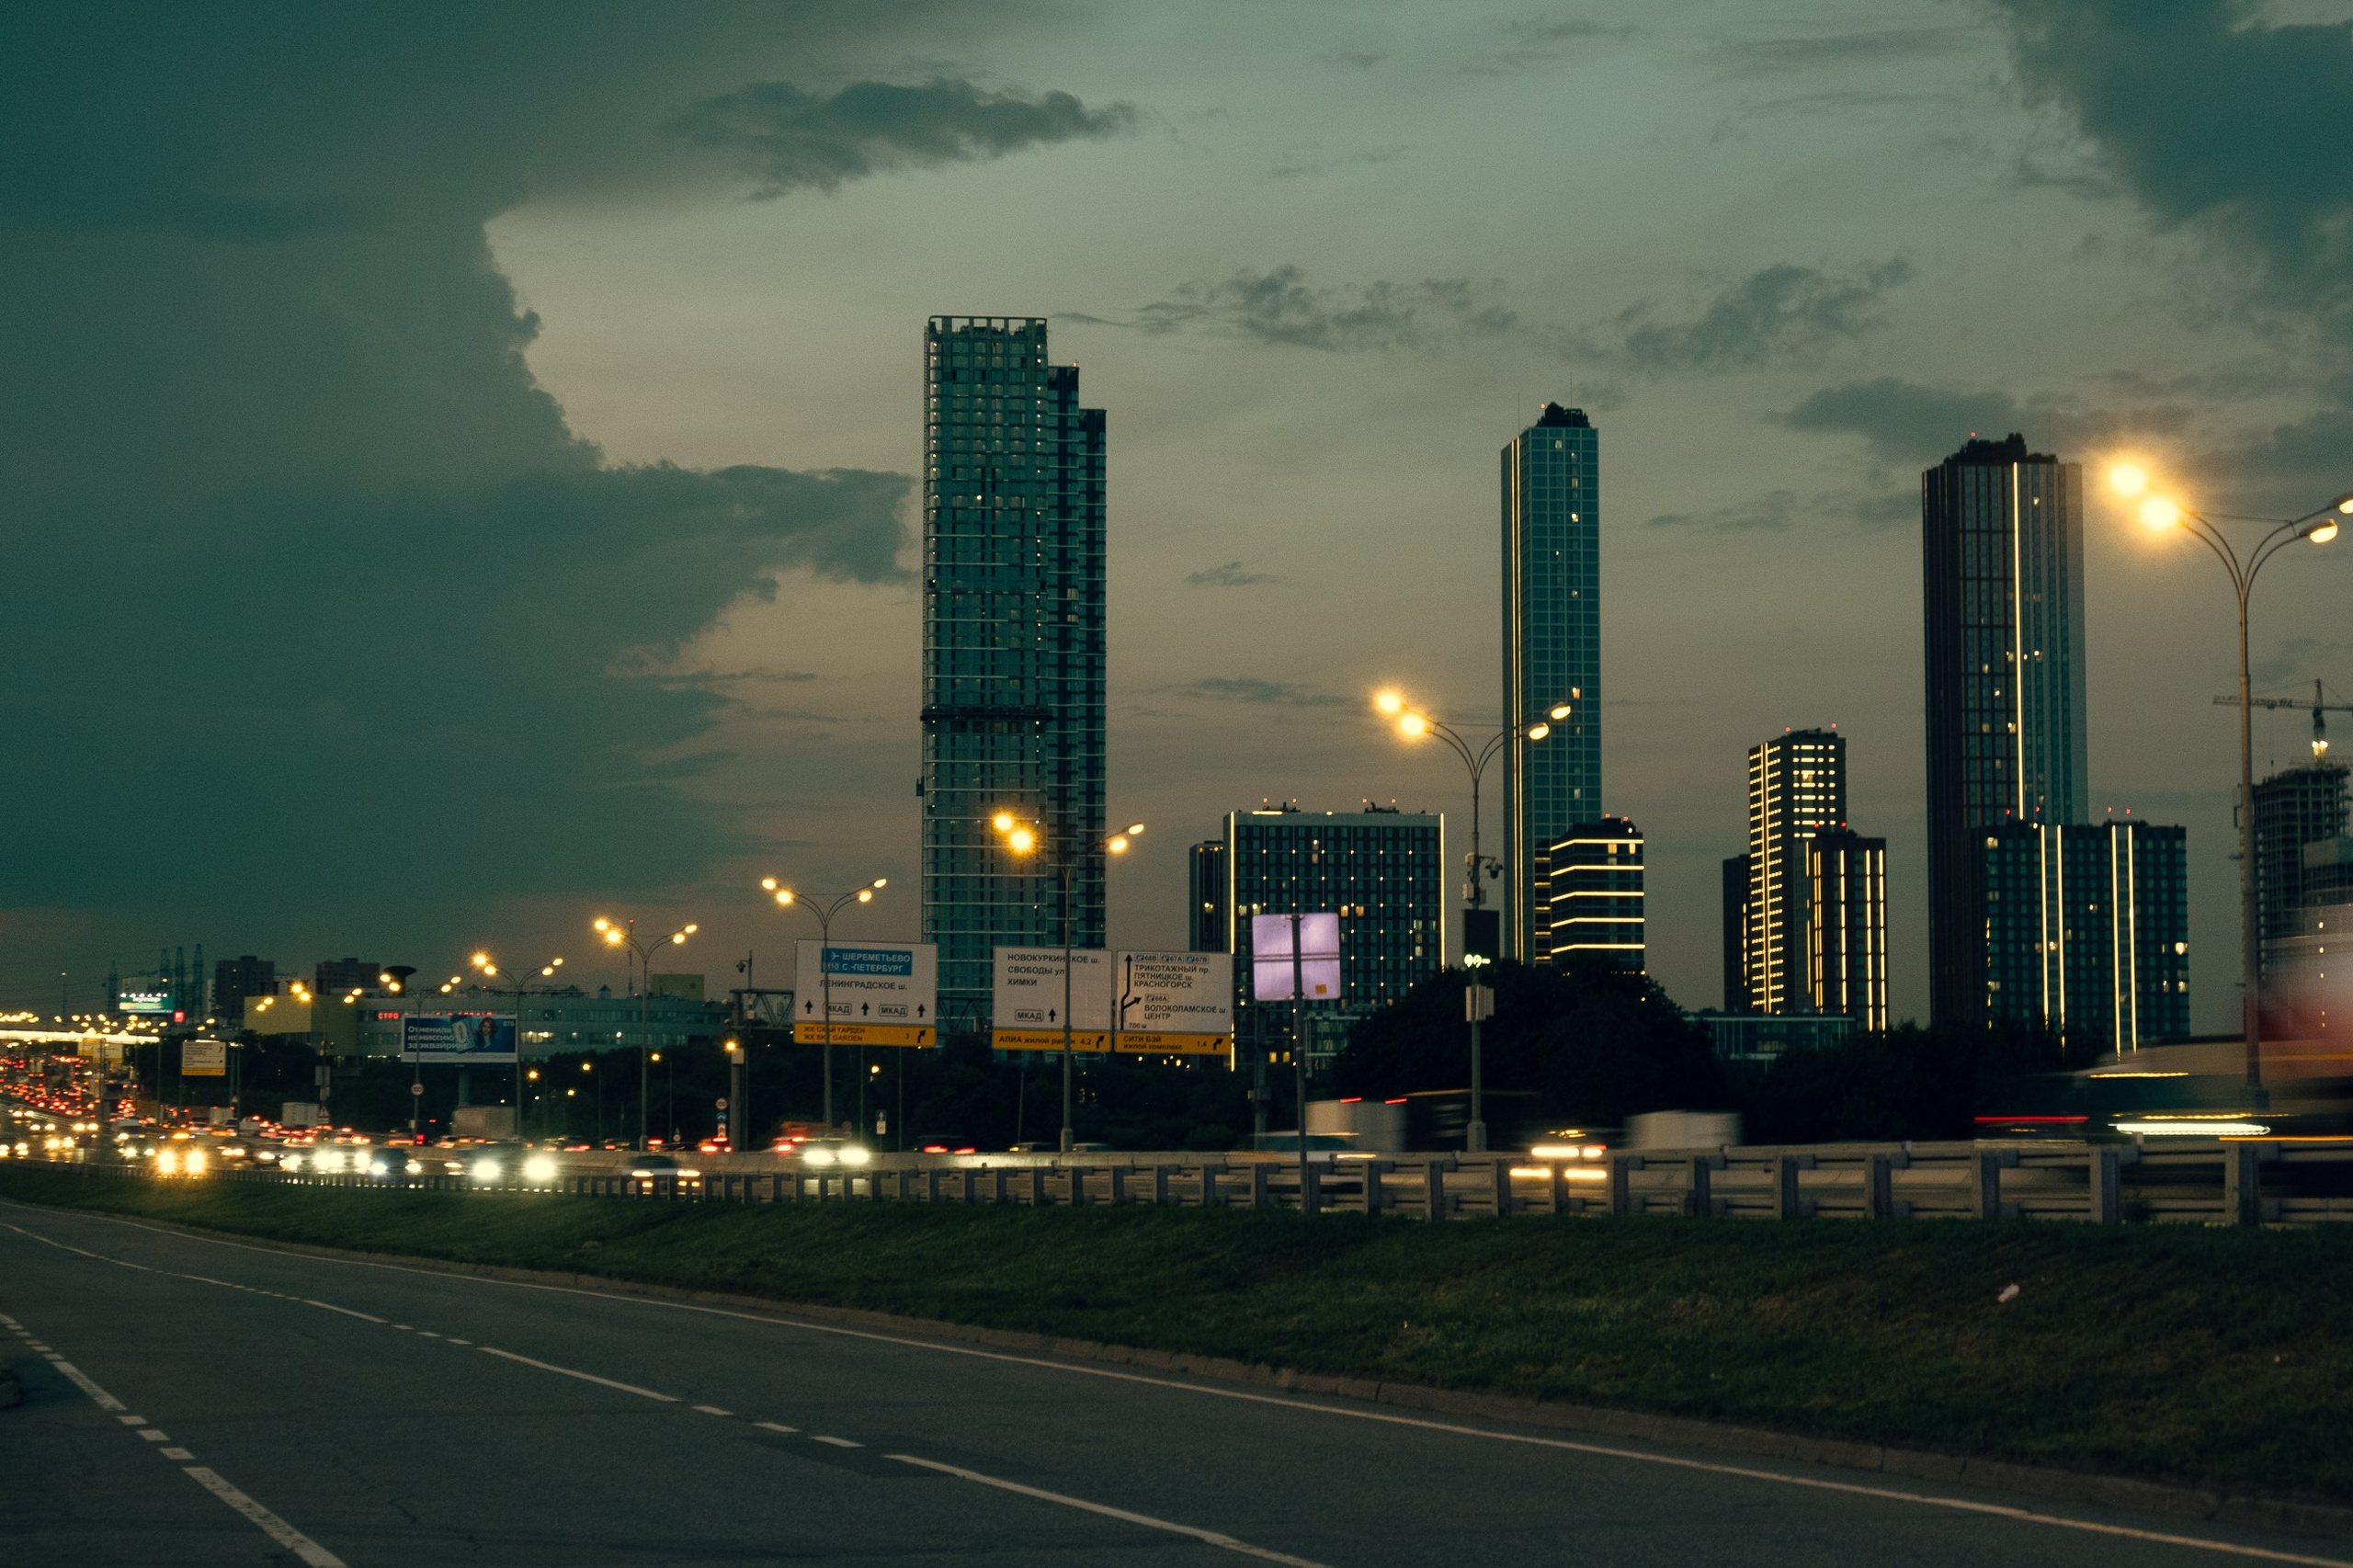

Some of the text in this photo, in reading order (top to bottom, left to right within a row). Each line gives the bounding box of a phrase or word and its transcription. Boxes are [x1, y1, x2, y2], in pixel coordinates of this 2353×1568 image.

[842, 953, 911, 962] ШЕРЕМЕТЬЕВО
[1007, 953, 1088, 963] НОВОКУРКИНКОЕ
[1007, 966, 1052, 975] СВОБОДЫ
[1134, 963, 1197, 972] ТРИКОТАЖНЫЙ
[881, 1006, 906, 1016] МКАД
[1144, 1005, 1217, 1013] ВОЛОКОЛАМСКОЕ
[1017, 1012, 1042, 1020] МКАД
[998, 1035, 1022, 1043] АЛИА
